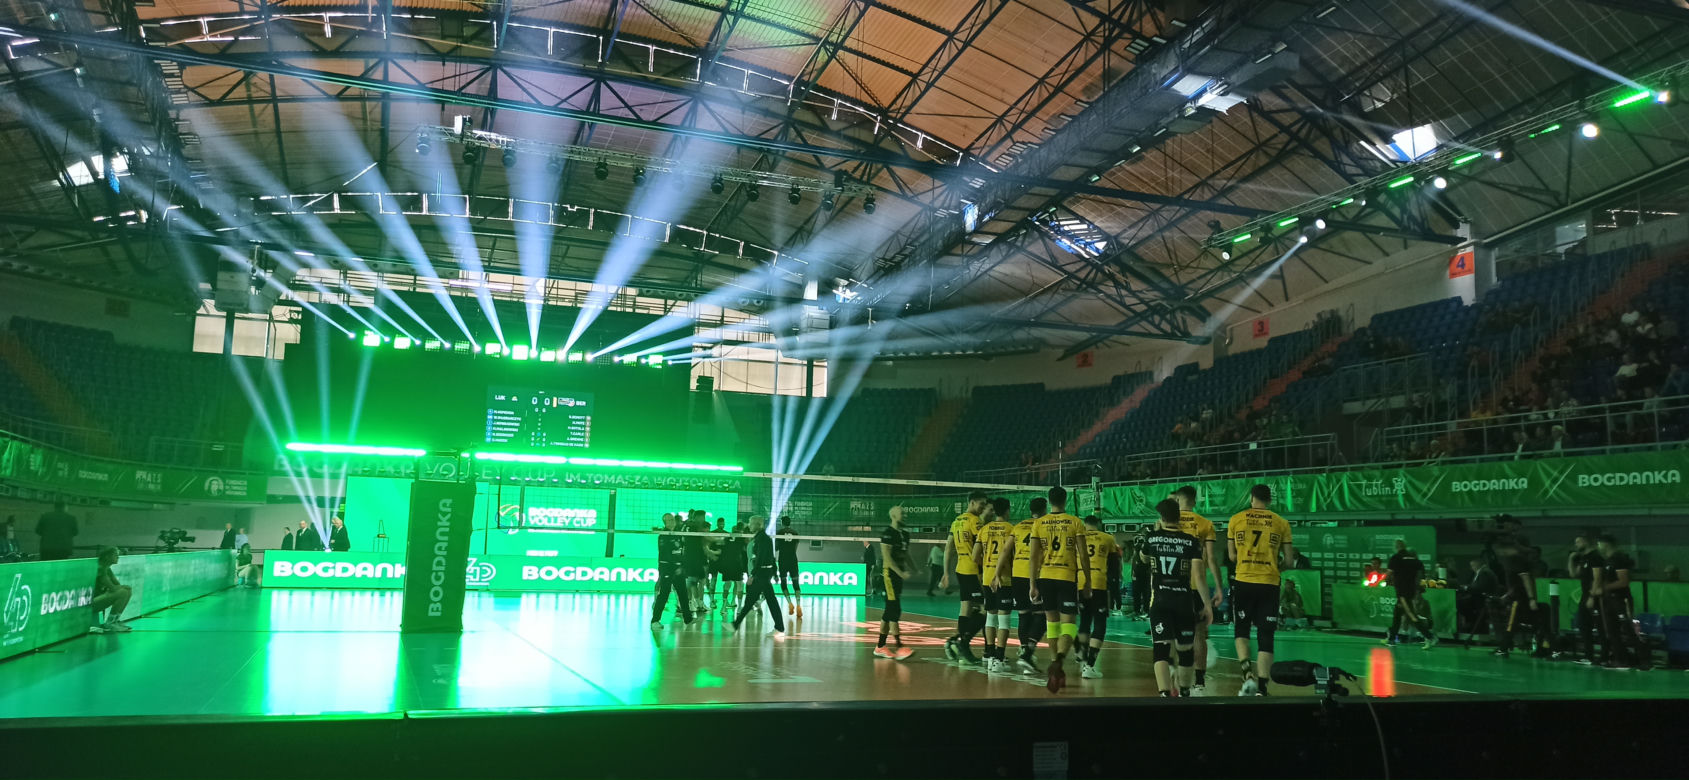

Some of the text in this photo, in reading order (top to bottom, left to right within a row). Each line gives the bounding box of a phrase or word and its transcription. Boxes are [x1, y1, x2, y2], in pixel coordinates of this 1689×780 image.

[1456, 256, 1466, 269] 4
[1257, 321, 1264, 332] 3
[1452, 477, 1528, 492] BOGDANKA
[1578, 469, 1681, 487] BOGDANKA
[528, 507, 597, 518] BOGDANKA
[529, 516, 597, 527] VOLLEY CUP
[1022, 533, 1031, 547] 4
[1051, 536, 1061, 551] 6
[1252, 530, 1263, 547] 7
[991, 540, 999, 555] 2
[1087, 544, 1096, 558] 3
[427, 498, 453, 617] BOGDANKA
[1159, 556, 1177, 575] 17
[522, 565, 659, 582] BOGDANKA
